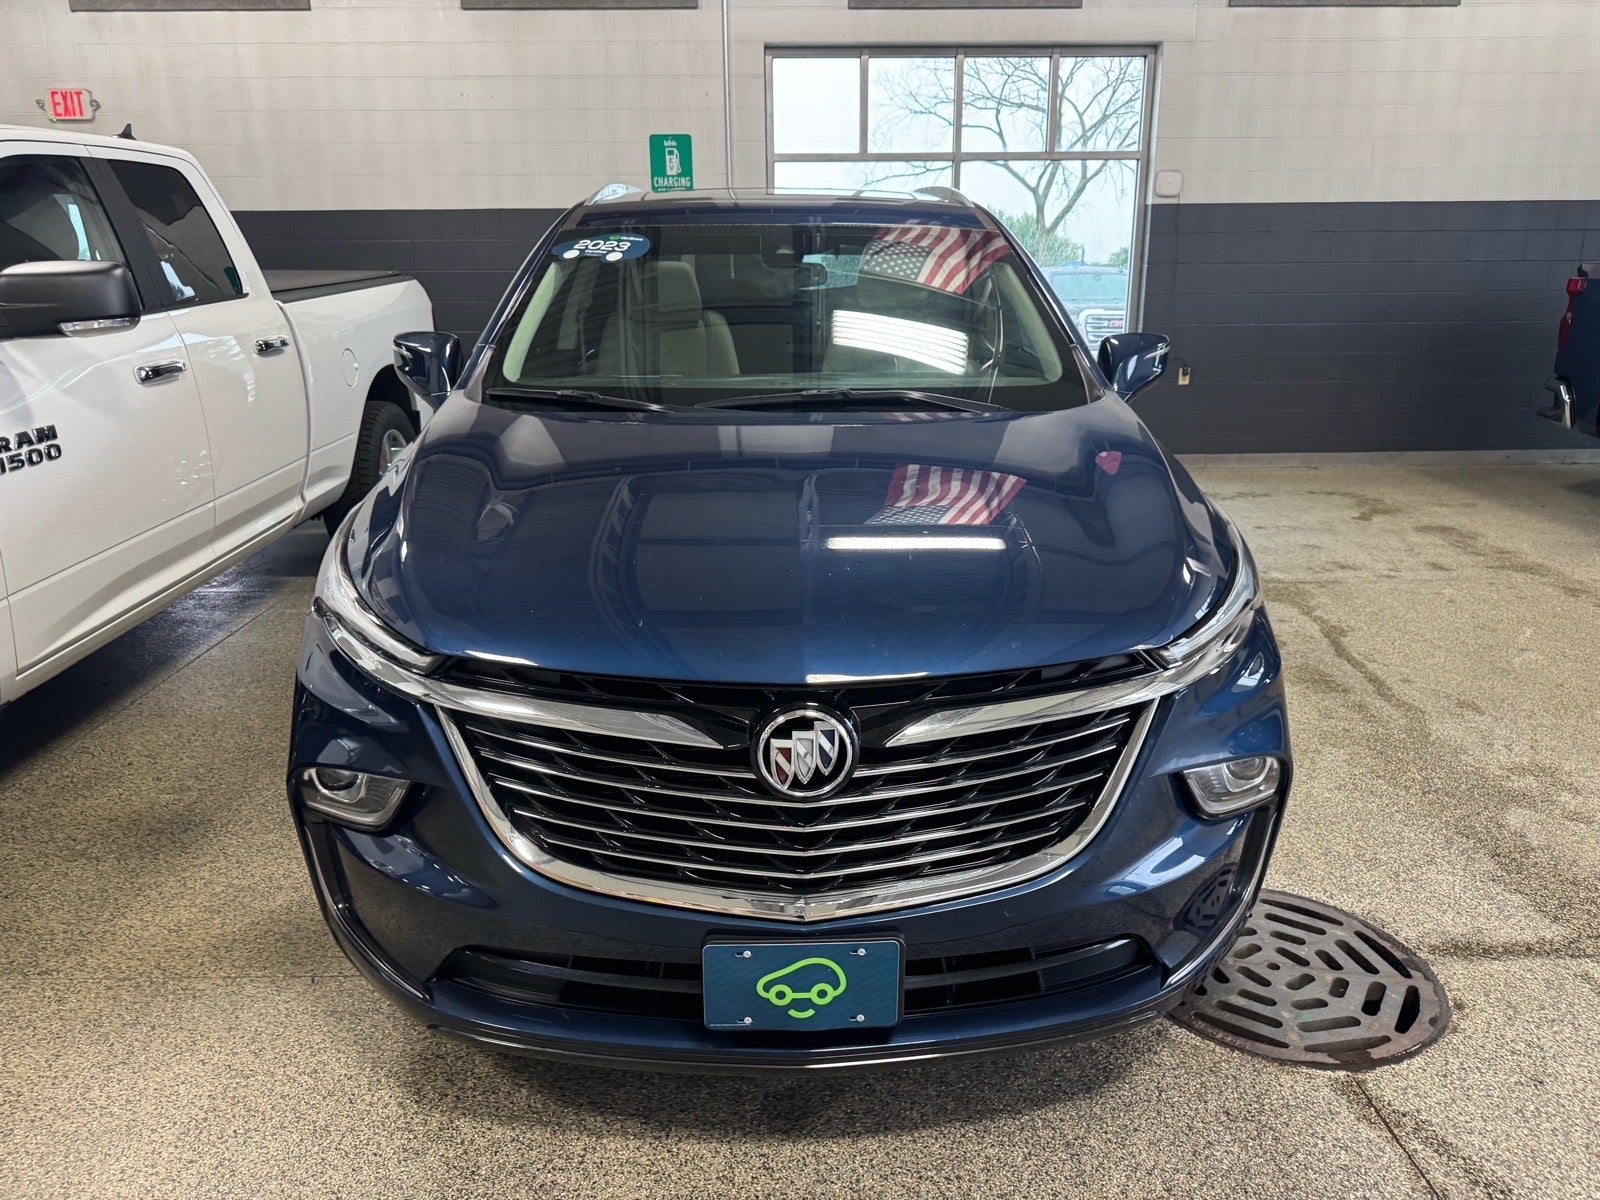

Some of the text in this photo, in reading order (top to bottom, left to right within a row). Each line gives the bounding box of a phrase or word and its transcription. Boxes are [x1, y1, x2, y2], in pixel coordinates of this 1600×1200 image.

[51, 91, 84, 117] EXIT
[653, 176, 691, 187] CHARGING
[573, 239, 631, 252] 2023
[0, 424, 58, 454] RAM
[0, 443, 62, 475] 1500
